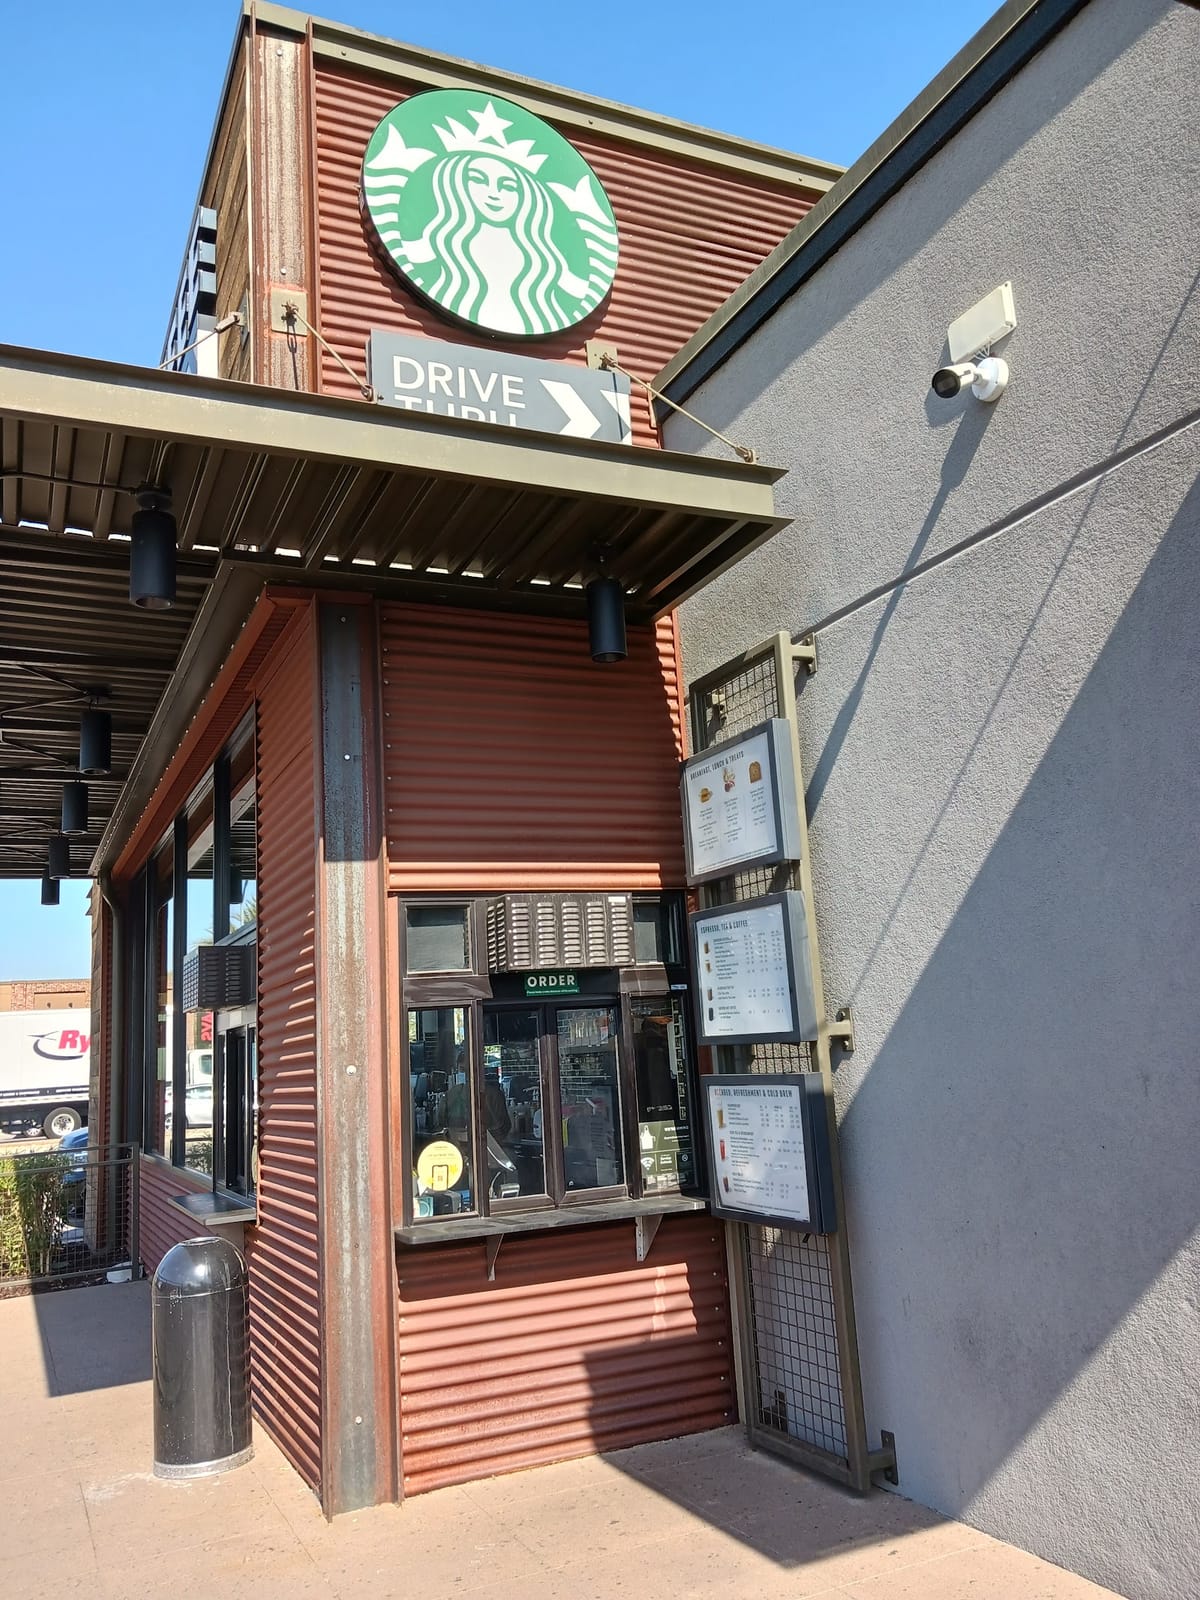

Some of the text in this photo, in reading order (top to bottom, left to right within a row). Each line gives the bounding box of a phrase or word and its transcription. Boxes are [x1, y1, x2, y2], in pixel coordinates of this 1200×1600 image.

[392, 355, 526, 409] DRIVE
[733, 919, 748, 929] COFFEE
[527, 974, 575, 988] ORDER
